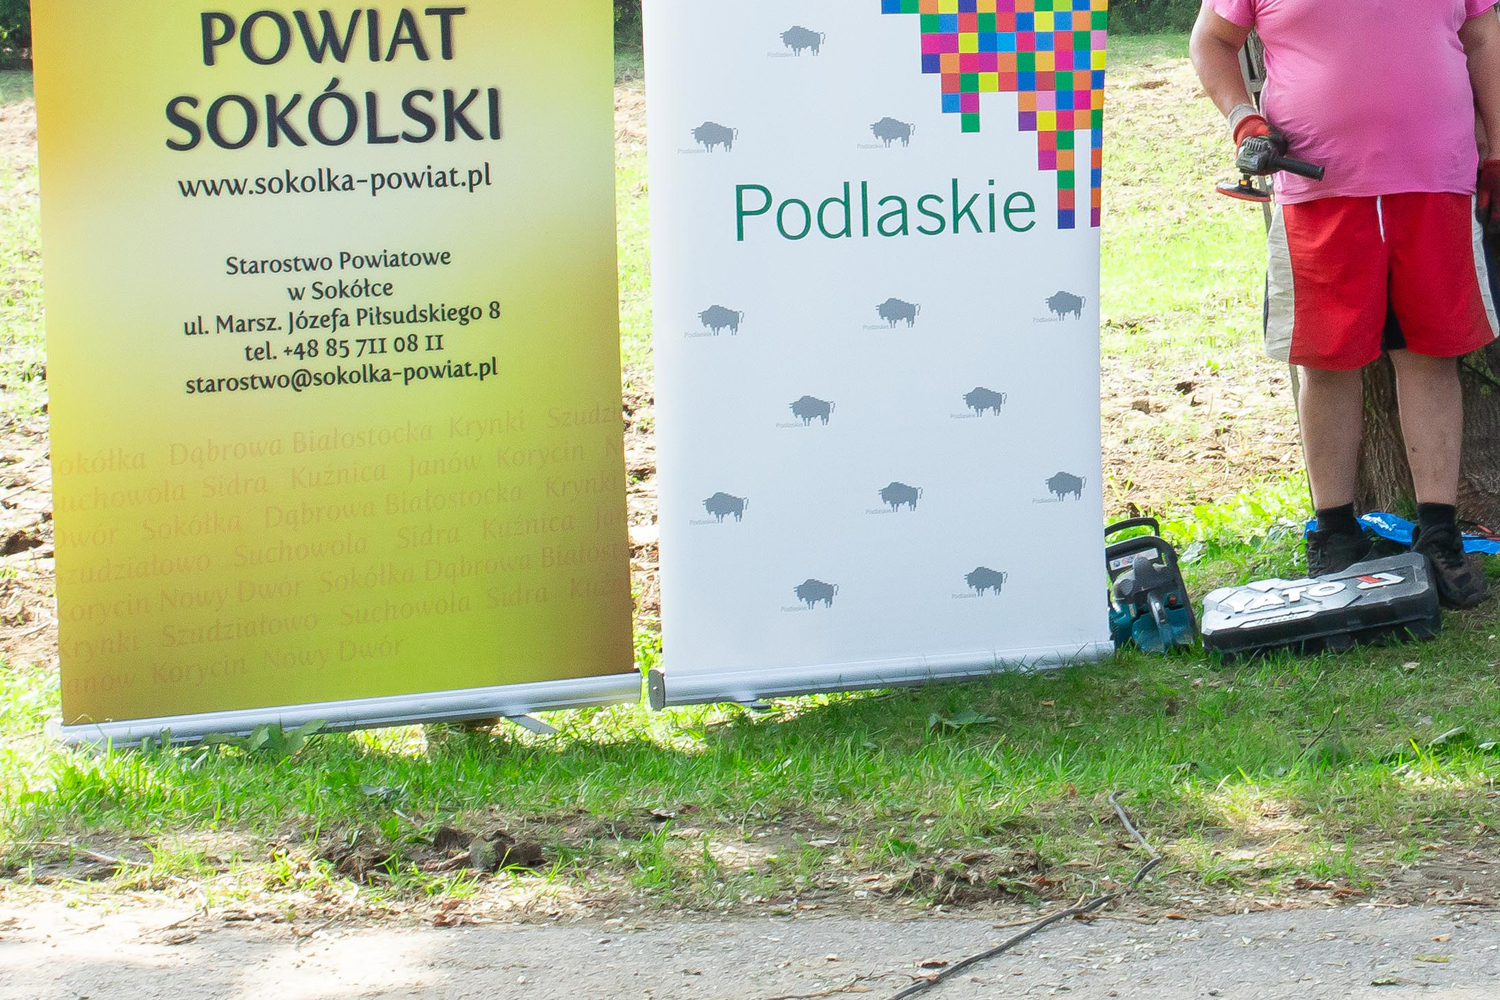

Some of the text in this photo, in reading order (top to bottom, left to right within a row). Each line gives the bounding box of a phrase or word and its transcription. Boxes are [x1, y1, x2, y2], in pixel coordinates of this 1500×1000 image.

[200, 6, 466, 67] POWIAT
[165, 76, 501, 152] SOKÓLSKI
[177, 161, 492, 198] www.sokolka-powiat.pl
[735, 178, 1037, 242] Podlaskie
[226, 249, 451, 275] Starostwo Powiatowe
[287, 277, 393, 301] w Sokółce
[184, 300, 501, 336] ul. Marsz. Józefa Piłsudskiego 8
[186, 355, 499, 394] starostwo@sokolka-powiat.pl
[244, 333, 444, 362] tel. +48 85 711 08 11
[54, 447, 146, 476] okółka
[169, 436, 283, 469] Dąbrowa
[292, 421, 434, 455] Białostocka
[449, 410, 527, 443] Krynki
[202, 472, 268, 499] Sidra
[290, 460, 387, 490] Kuźnica
[408, 450, 479, 483] Janów
[496, 441, 585, 471] Korycin
[142, 511, 241, 543] Sokółka
[265, 500, 376, 532] Dąbrowa
[385, 482, 523, 516] Białostocka
[544, 469, 619, 502] Krynki
[234, 534, 368, 568] Suchowola
[397, 523, 460, 550] Sidra
[483, 512, 576, 540] Kuźnica
[160, 586, 228, 612] Nowy
[237, 576, 304, 603] Dwór
[319, 563, 415, 594] Sokółka
[425, 552, 531, 585] Dąbrowa
[1227, 581, 1346, 613] YATO
[162, 612, 318, 647] Szudziałowo
[340, 592, 471, 627] Suchowola
[65, 670, 133, 696] anów
[152, 656, 245, 686] Korycin
[339, 635, 404, 663] Dwór
